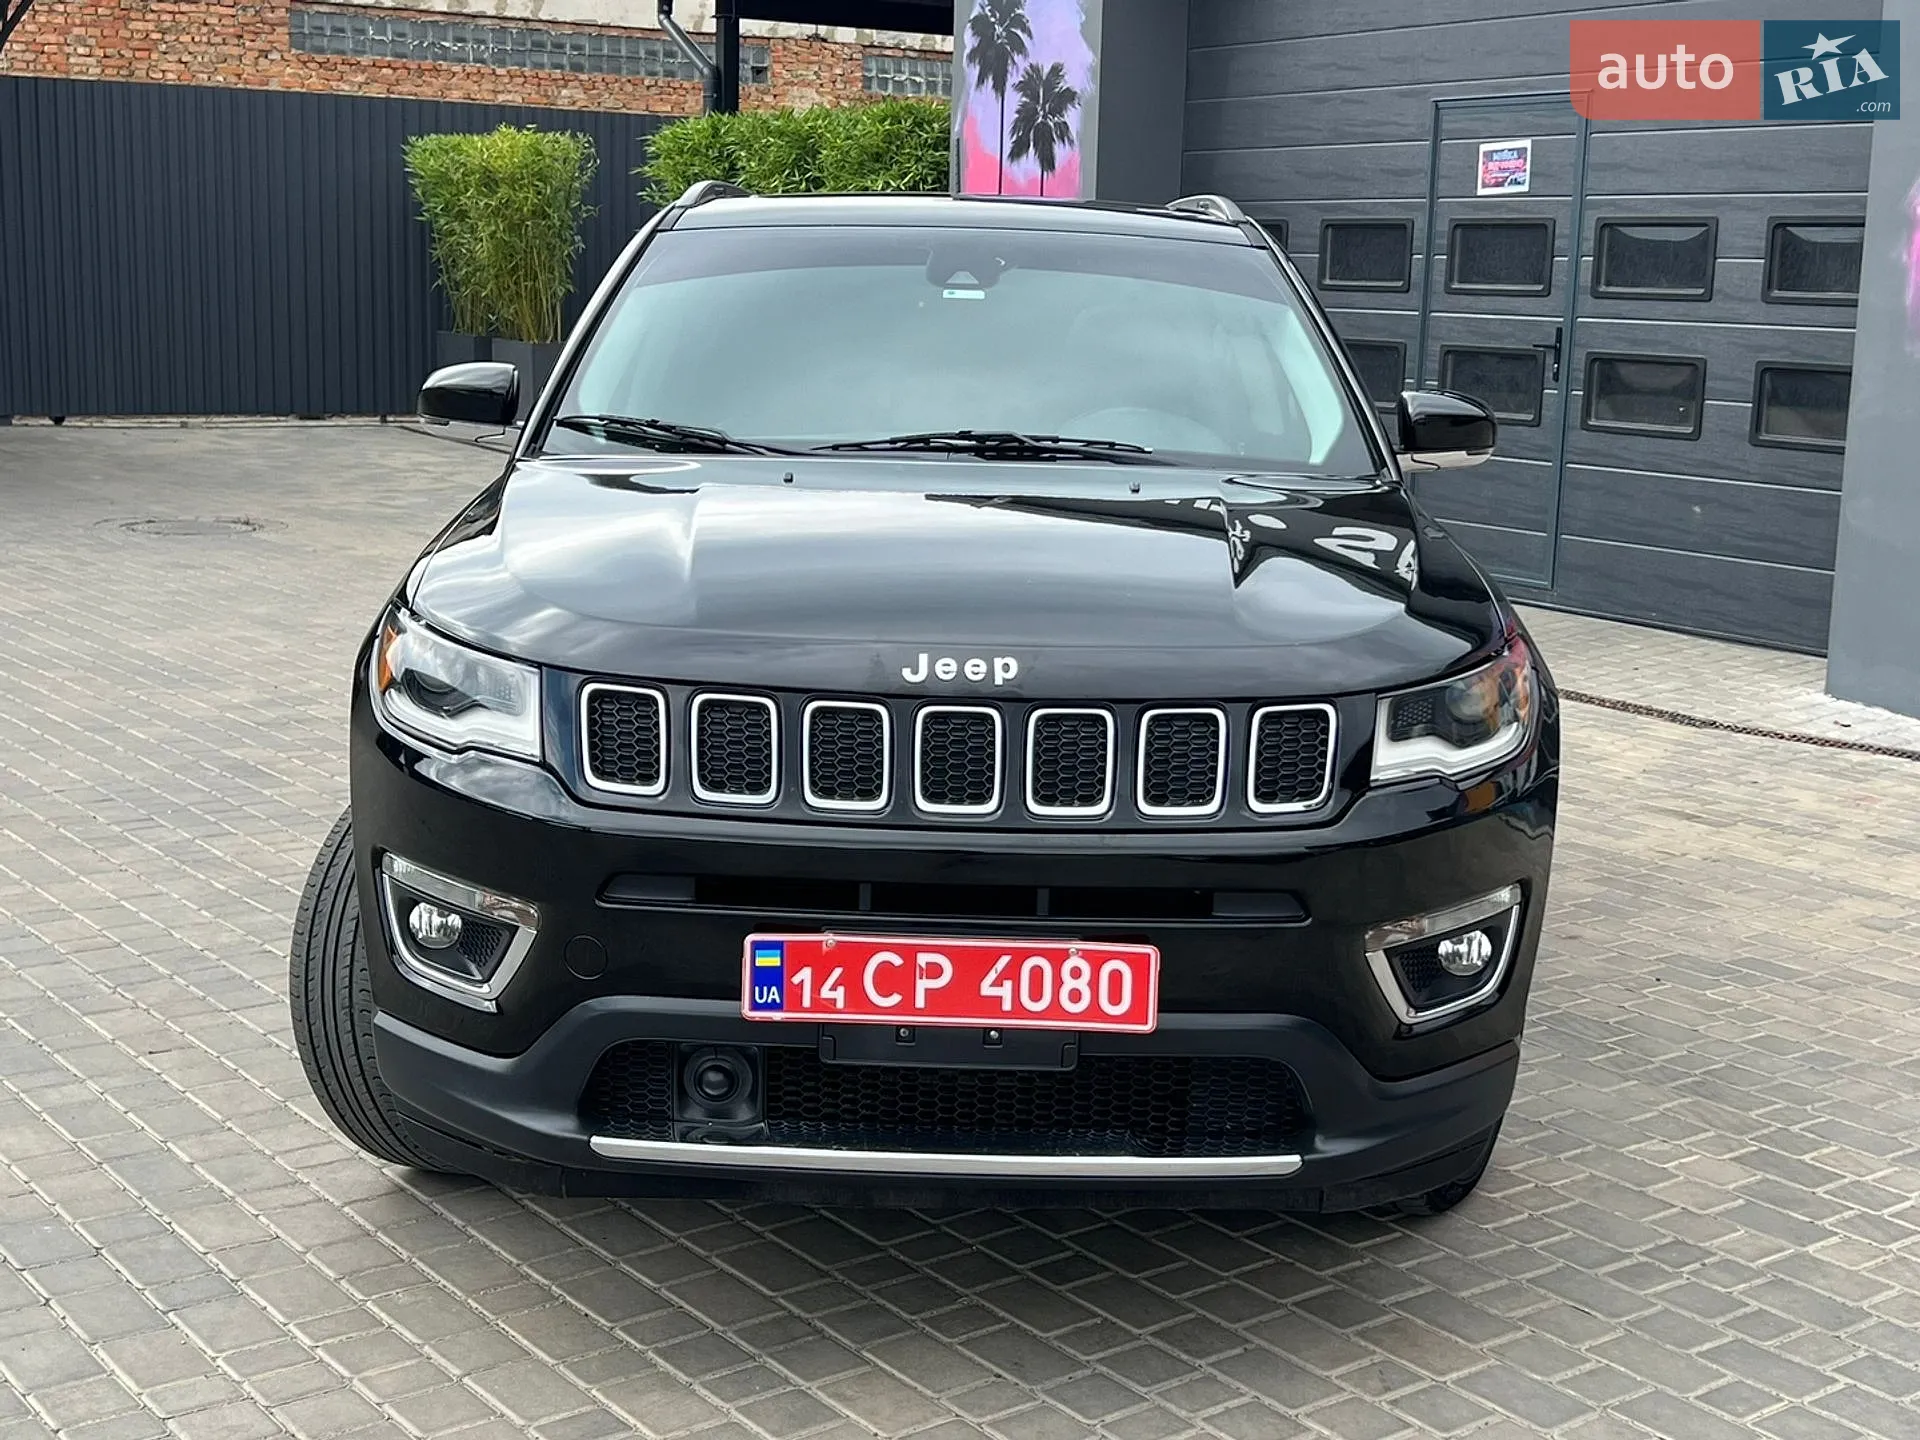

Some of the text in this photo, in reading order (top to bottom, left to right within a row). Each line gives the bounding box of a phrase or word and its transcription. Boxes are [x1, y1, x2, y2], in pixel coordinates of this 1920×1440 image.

[901, 653, 1019, 686] Jeep
[754, 985, 781, 1004] UA
[790, 950, 1133, 1016] 14 CP 4080
